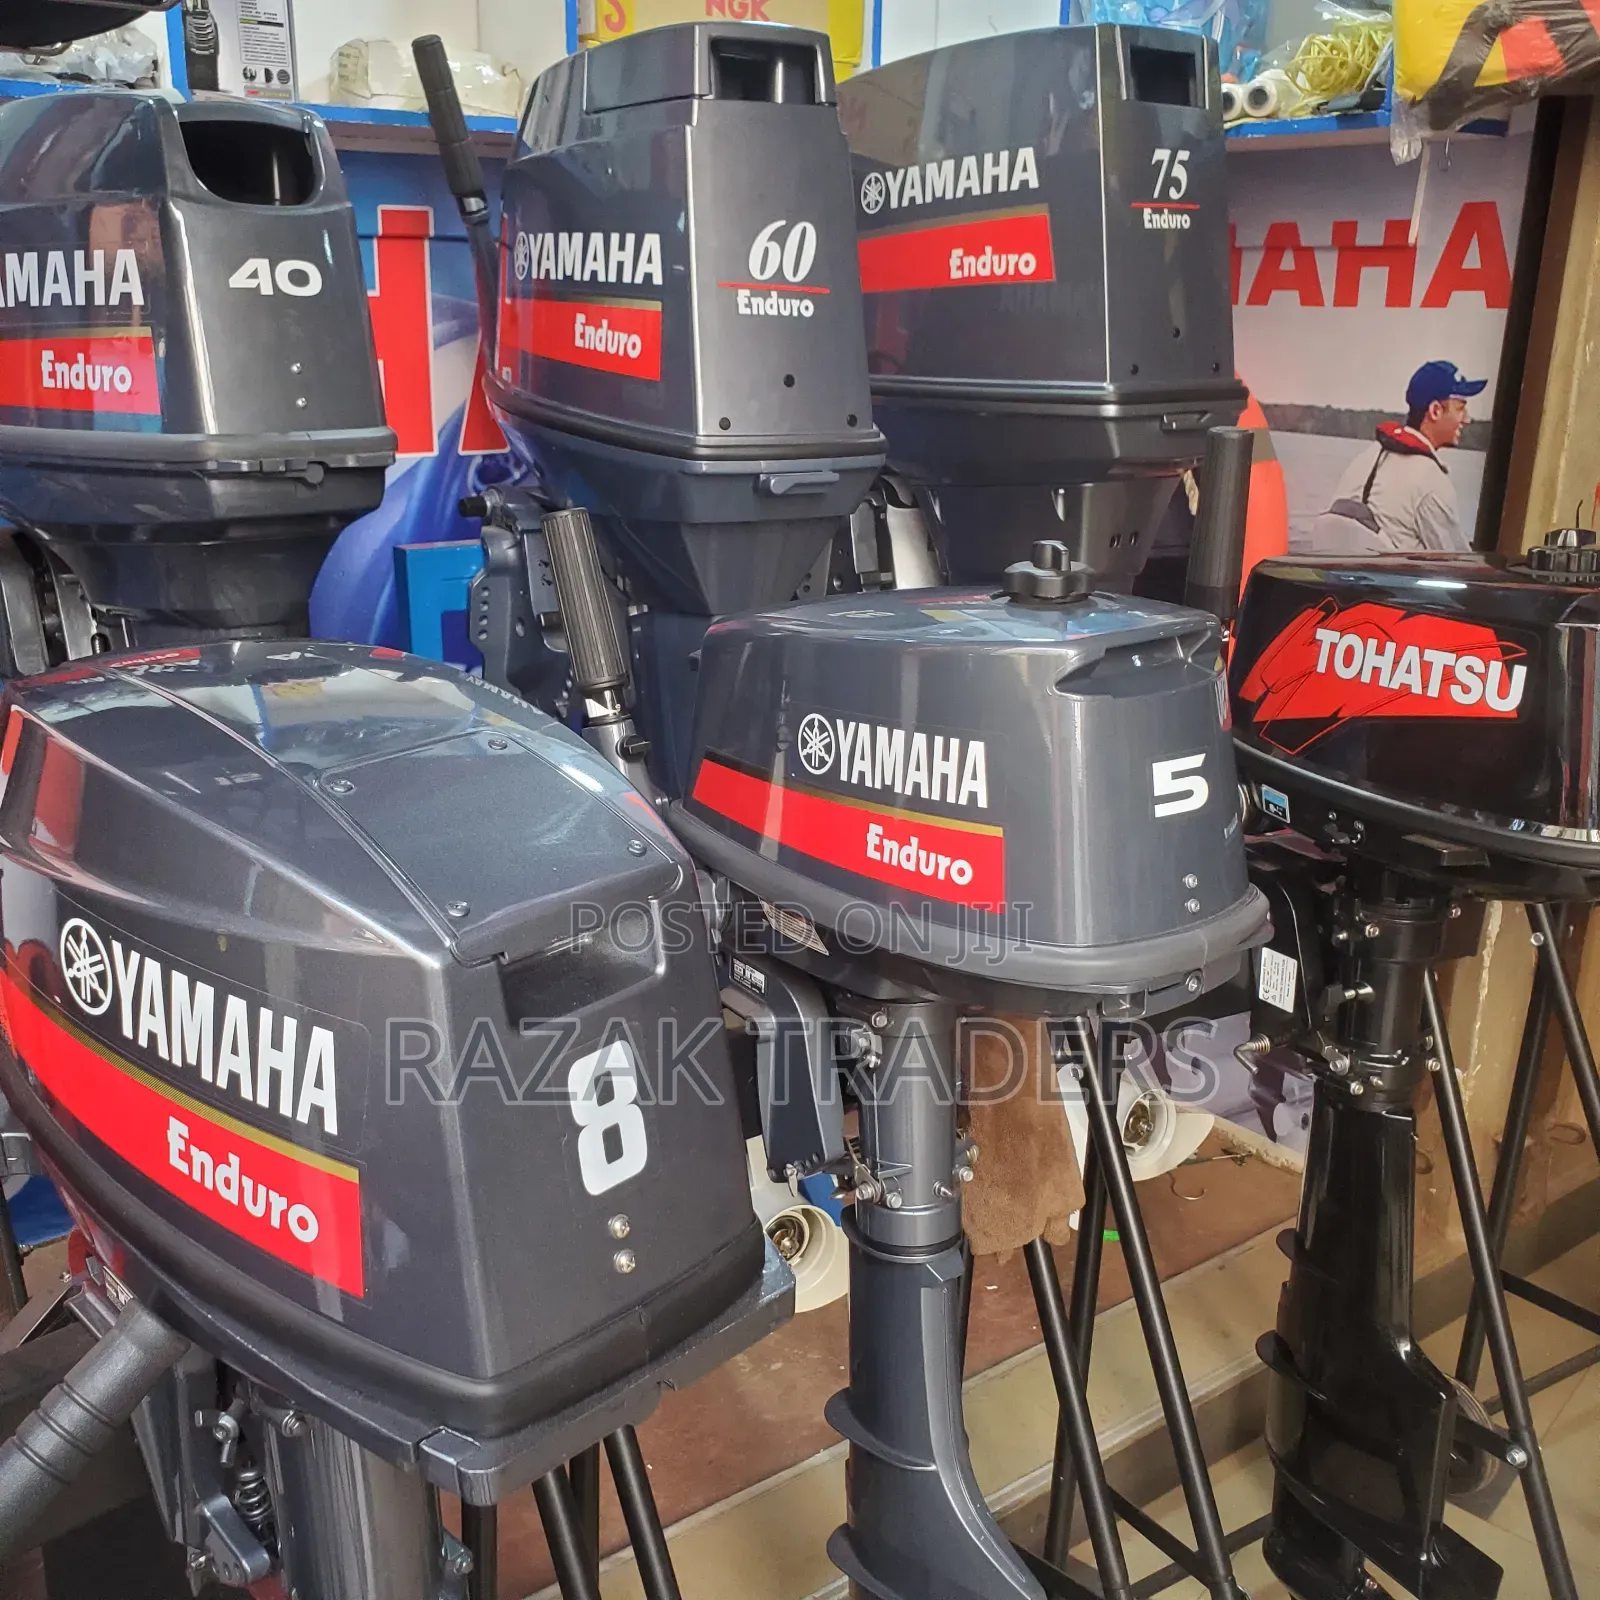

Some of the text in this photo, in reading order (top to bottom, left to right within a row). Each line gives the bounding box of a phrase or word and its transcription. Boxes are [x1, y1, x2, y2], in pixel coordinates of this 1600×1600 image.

[704, 0, 771, 21] NGK
[885, 147, 1040, 209] YAMAHA
[1151, 148, 1191, 200] 75
[1142, 207, 1191, 230] Enduro
[0, 248, 145, 308] MAHA
[228, 258, 323, 297] 40
[528, 232, 663, 286] YAMAHA
[748, 219, 817, 283] 60
[949, 246, 1037, 280] Enduro
[1230, 201, 1512, 309] AHA
[736, 289, 815, 319] Enduro
[574, 313, 642, 360] Enduro
[41, 350, 132, 393] Enduro
[1315, 628, 1528, 712] TOHATSU
[835, 718, 989, 809] YAMAHA
[1151, 752, 1210, 819] 5
[866, 823, 974, 886] Enduro
[111, 939, 338, 1136] YAMAHA
[565, 1039, 648, 1197] 8
[167, 1116, 319, 1243] Enduro
